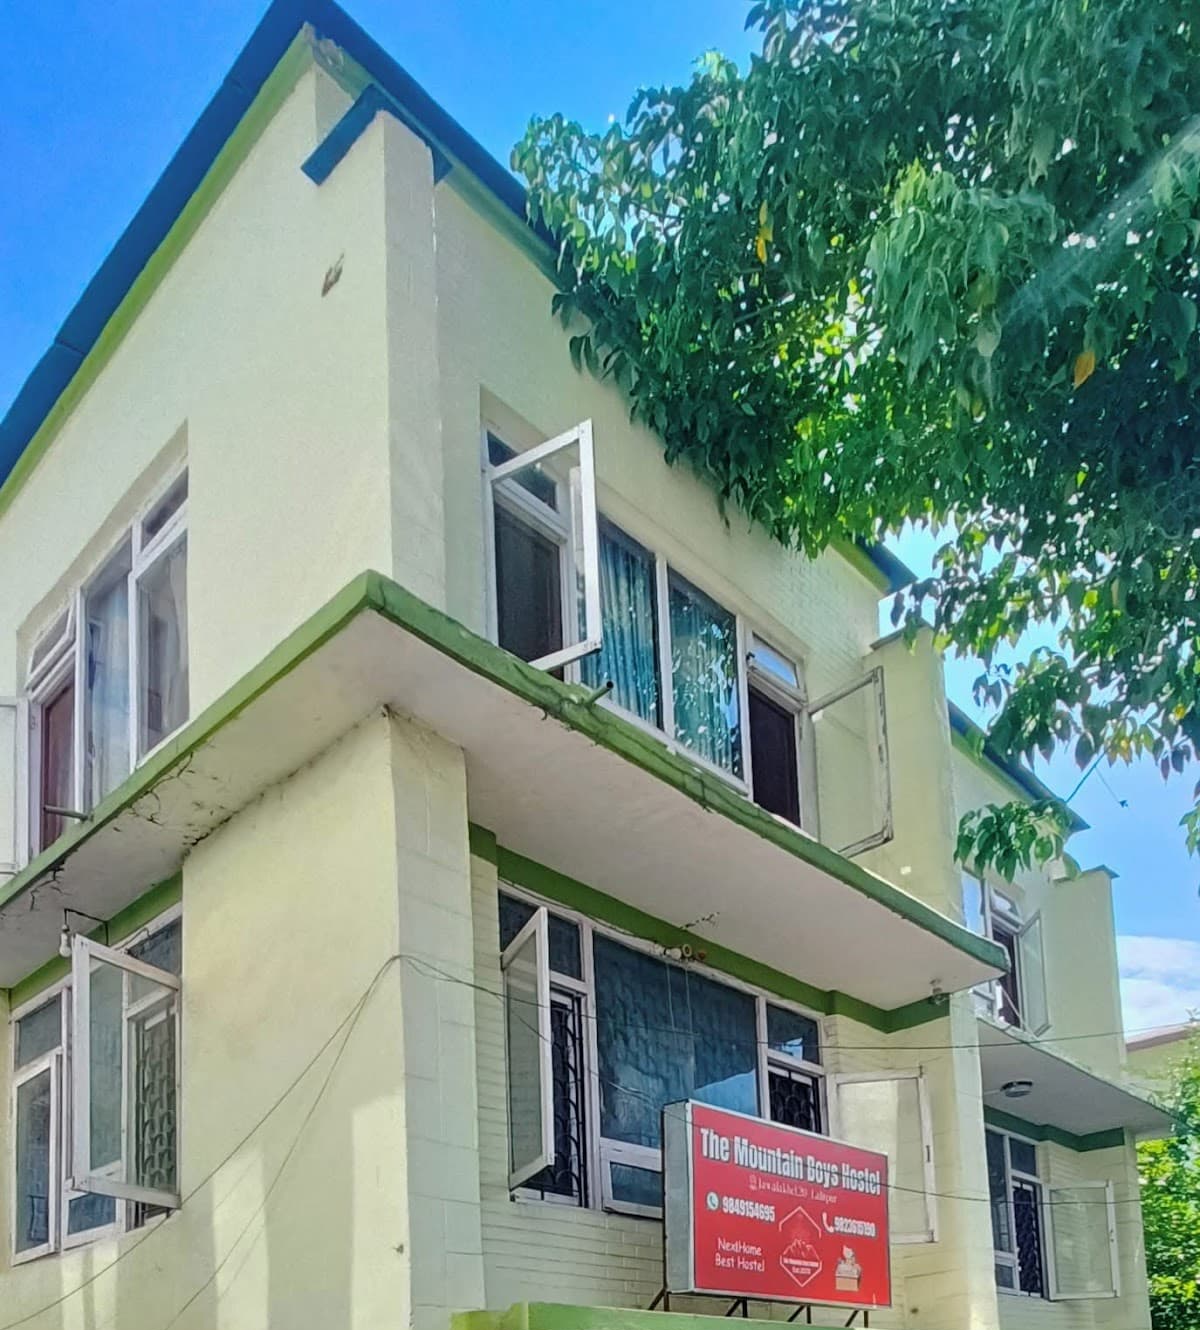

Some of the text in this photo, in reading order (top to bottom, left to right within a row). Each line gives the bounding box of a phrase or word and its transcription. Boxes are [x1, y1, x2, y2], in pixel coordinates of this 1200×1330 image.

[701, 1128, 881, 1196] The Mountain Boys Hostel
[715, 1253, 734, 1268] Best
[737, 1256, 765, 1272] Hostel
